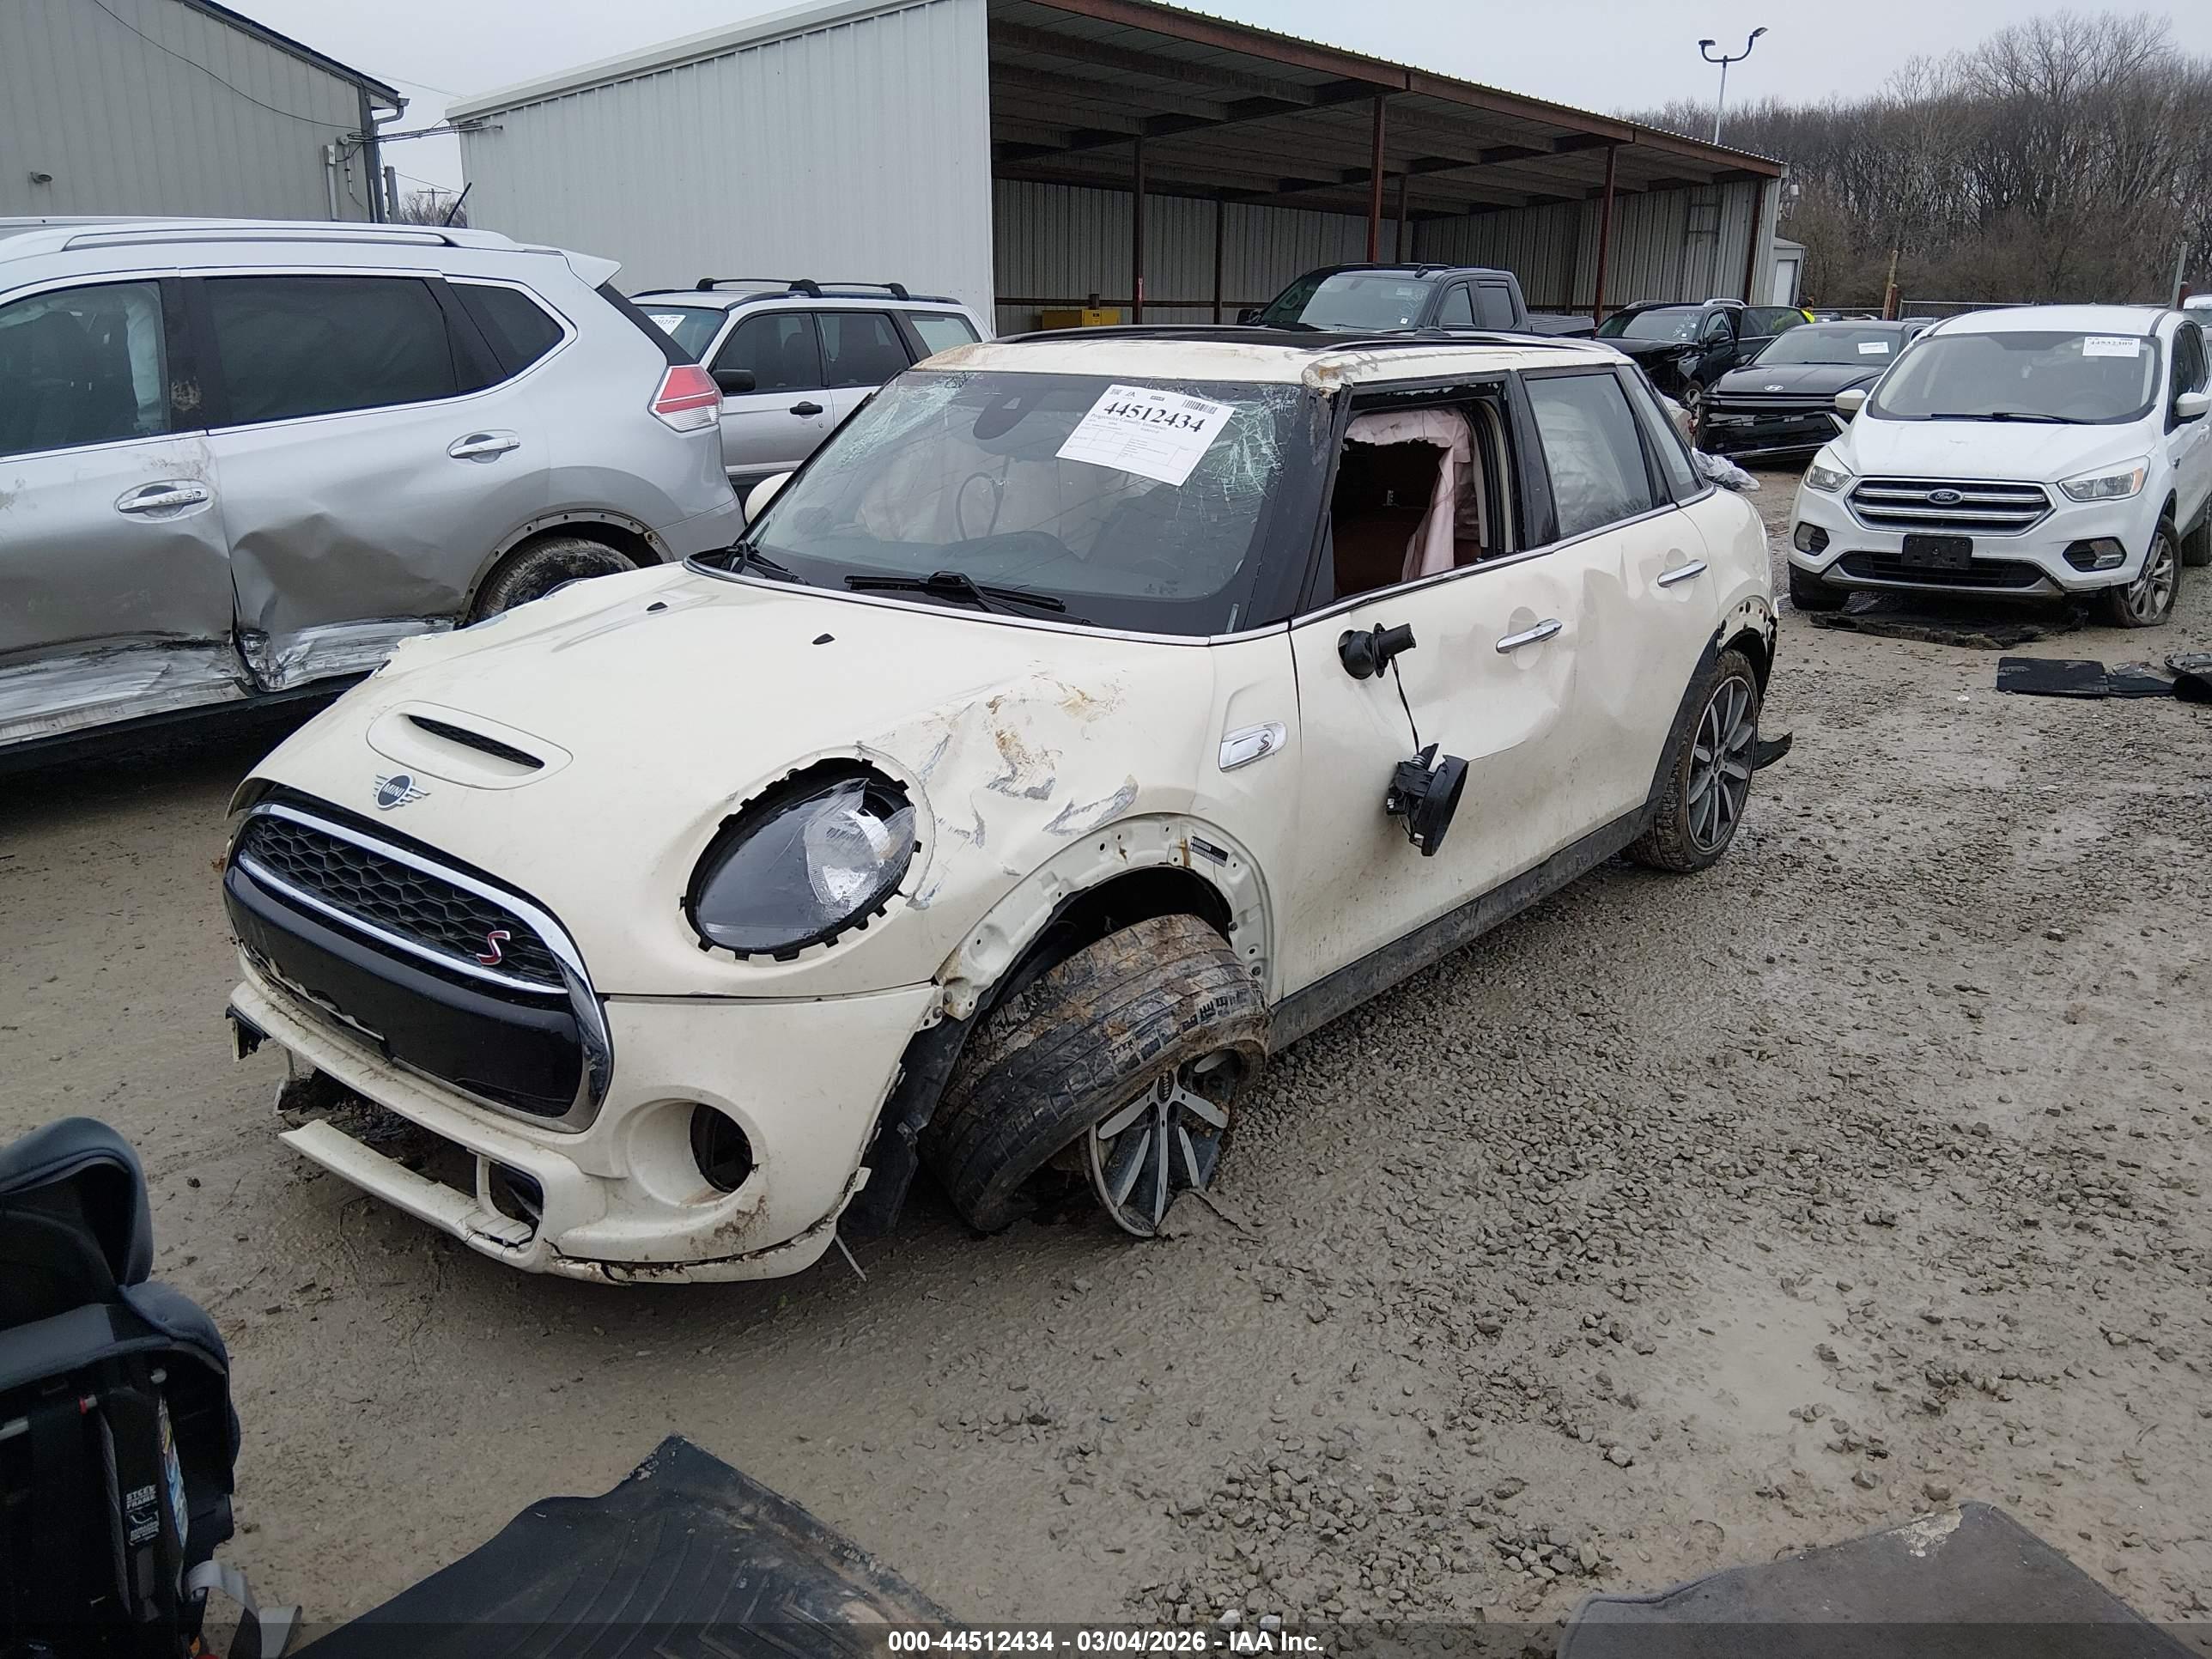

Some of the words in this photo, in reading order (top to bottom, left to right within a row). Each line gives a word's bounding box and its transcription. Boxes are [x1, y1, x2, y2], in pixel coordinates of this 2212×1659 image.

[1104, 401, 1206, 433] 44512434
[1935, 491, 1955, 501] Ford
[382, 782, 405, 798] MINI
[476, 930, 511, 965] S
